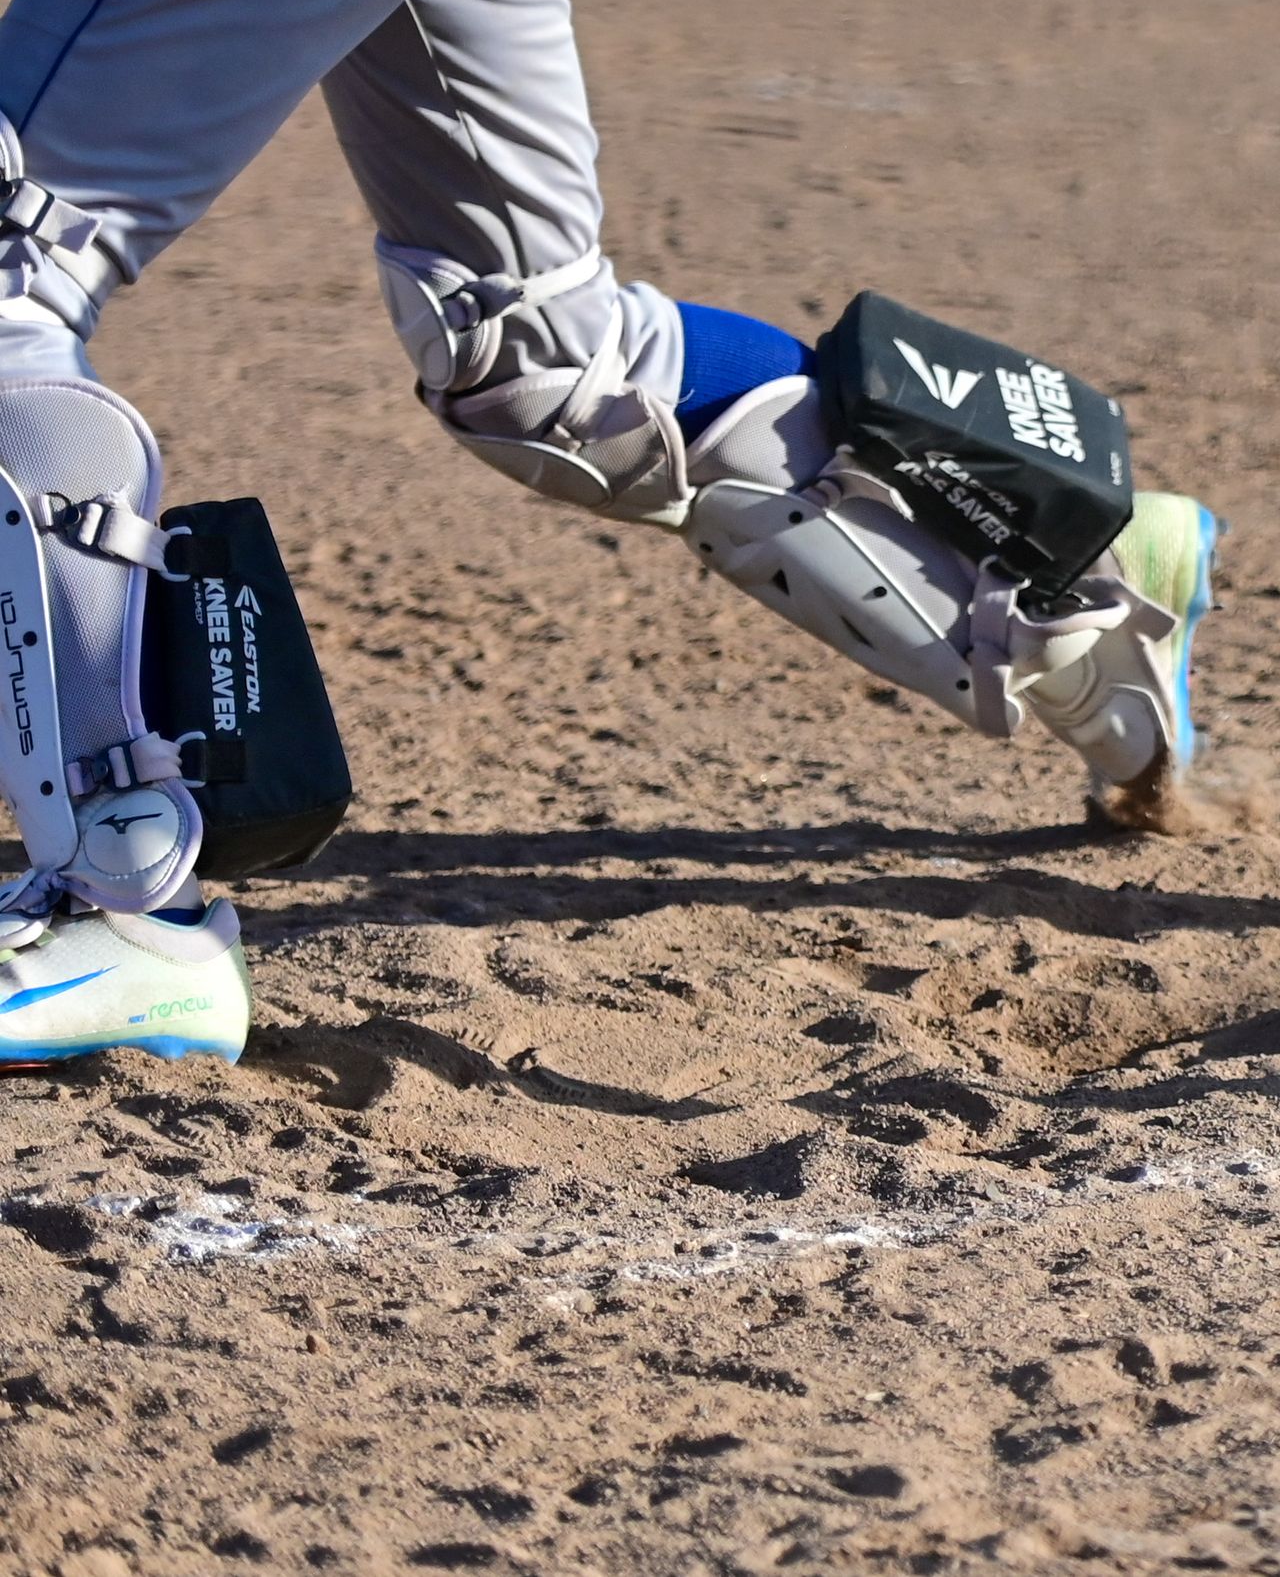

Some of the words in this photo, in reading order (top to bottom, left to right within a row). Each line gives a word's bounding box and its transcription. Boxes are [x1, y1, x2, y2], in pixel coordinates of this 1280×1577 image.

[994, 365, 1048, 450] KNEE
[1030, 364, 1087, 464] SAVER
[945, 486, 1011, 545] SAVER
[202, 577, 231, 643] KNEE
[0, 590, 34, 757] samurai
[209, 647, 237, 732] SAVER
[240, 609, 262, 713] EASTON
